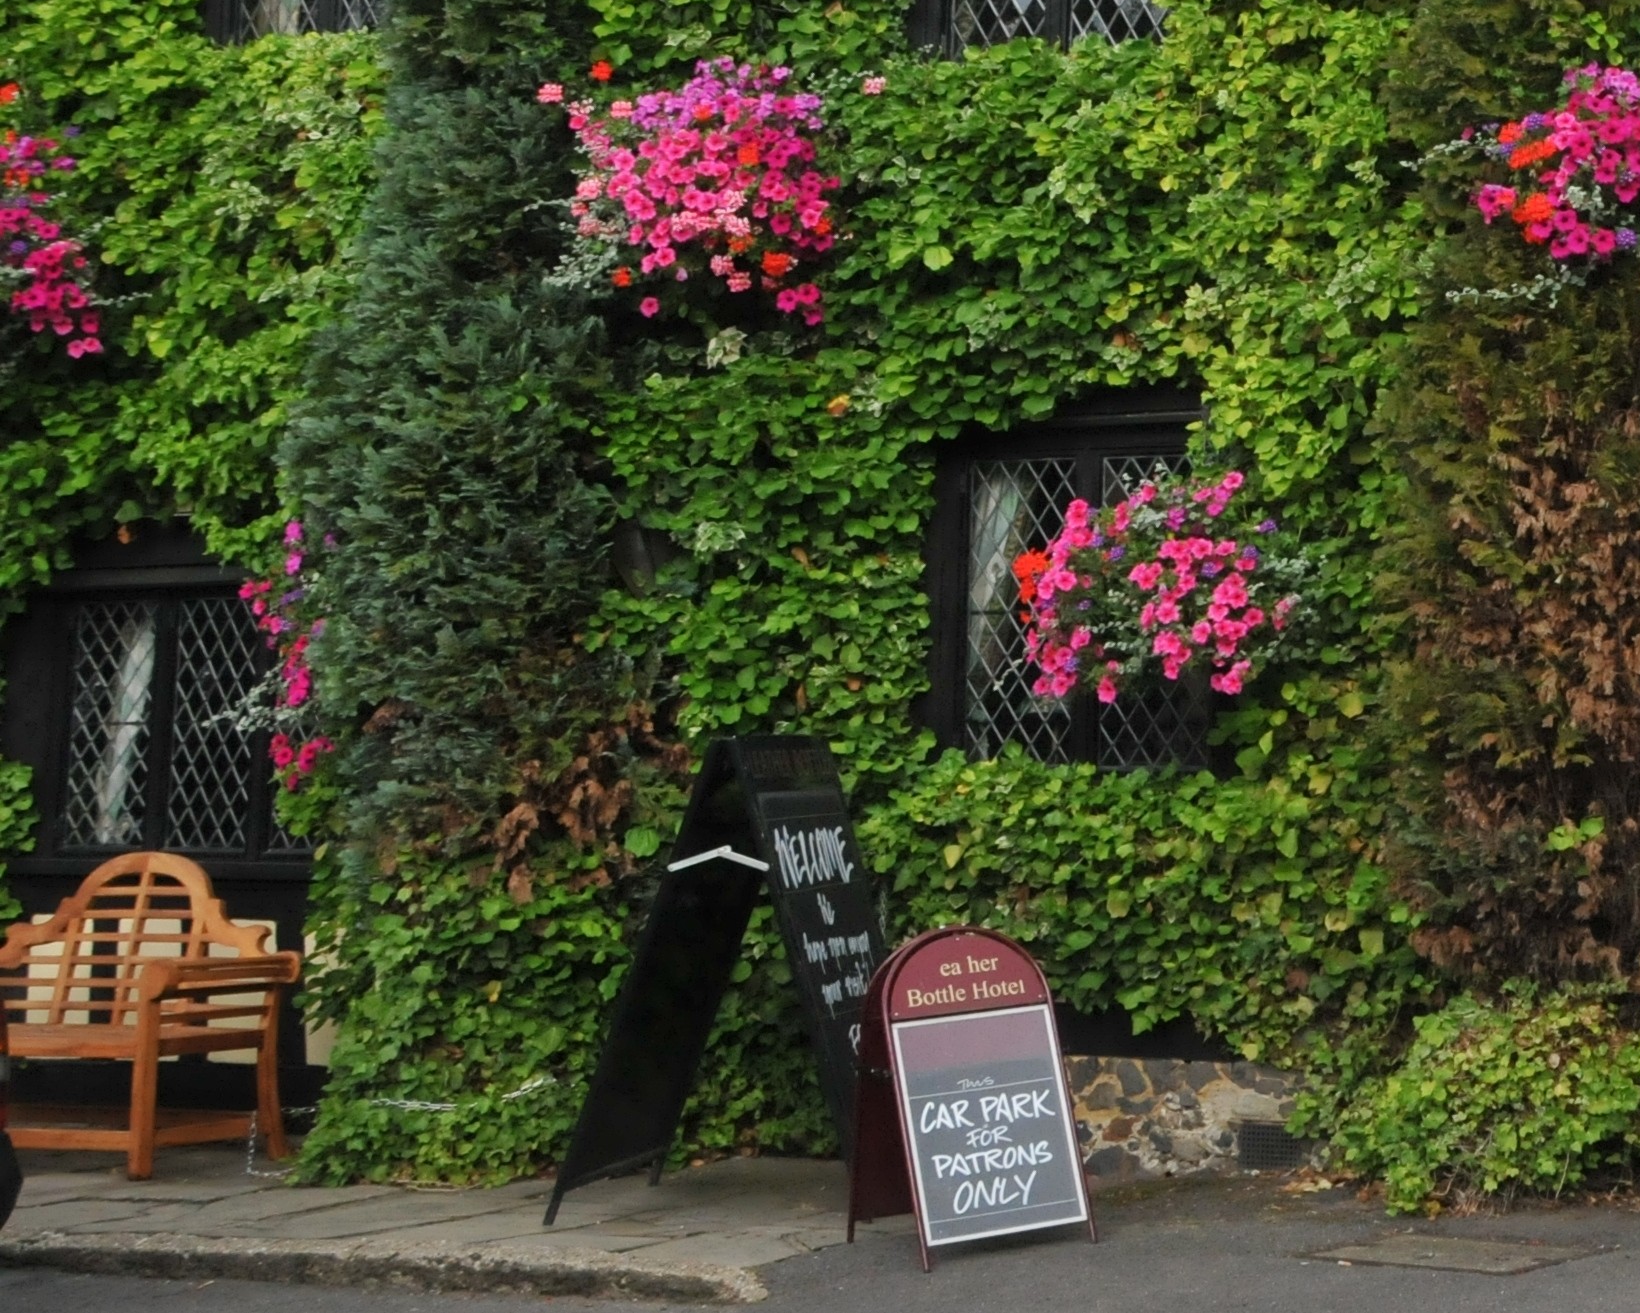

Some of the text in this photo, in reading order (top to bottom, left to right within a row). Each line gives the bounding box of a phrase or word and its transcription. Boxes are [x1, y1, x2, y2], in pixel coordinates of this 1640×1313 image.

[907, 979, 1026, 1008] Bottle Hotel
[920, 1088, 1056, 1134] CAR PARK
[966, 1125, 1013, 1149] FOR
[932, 1141, 1054, 1179] PATRONS
[953, 1170, 1038, 1215] ONLY
